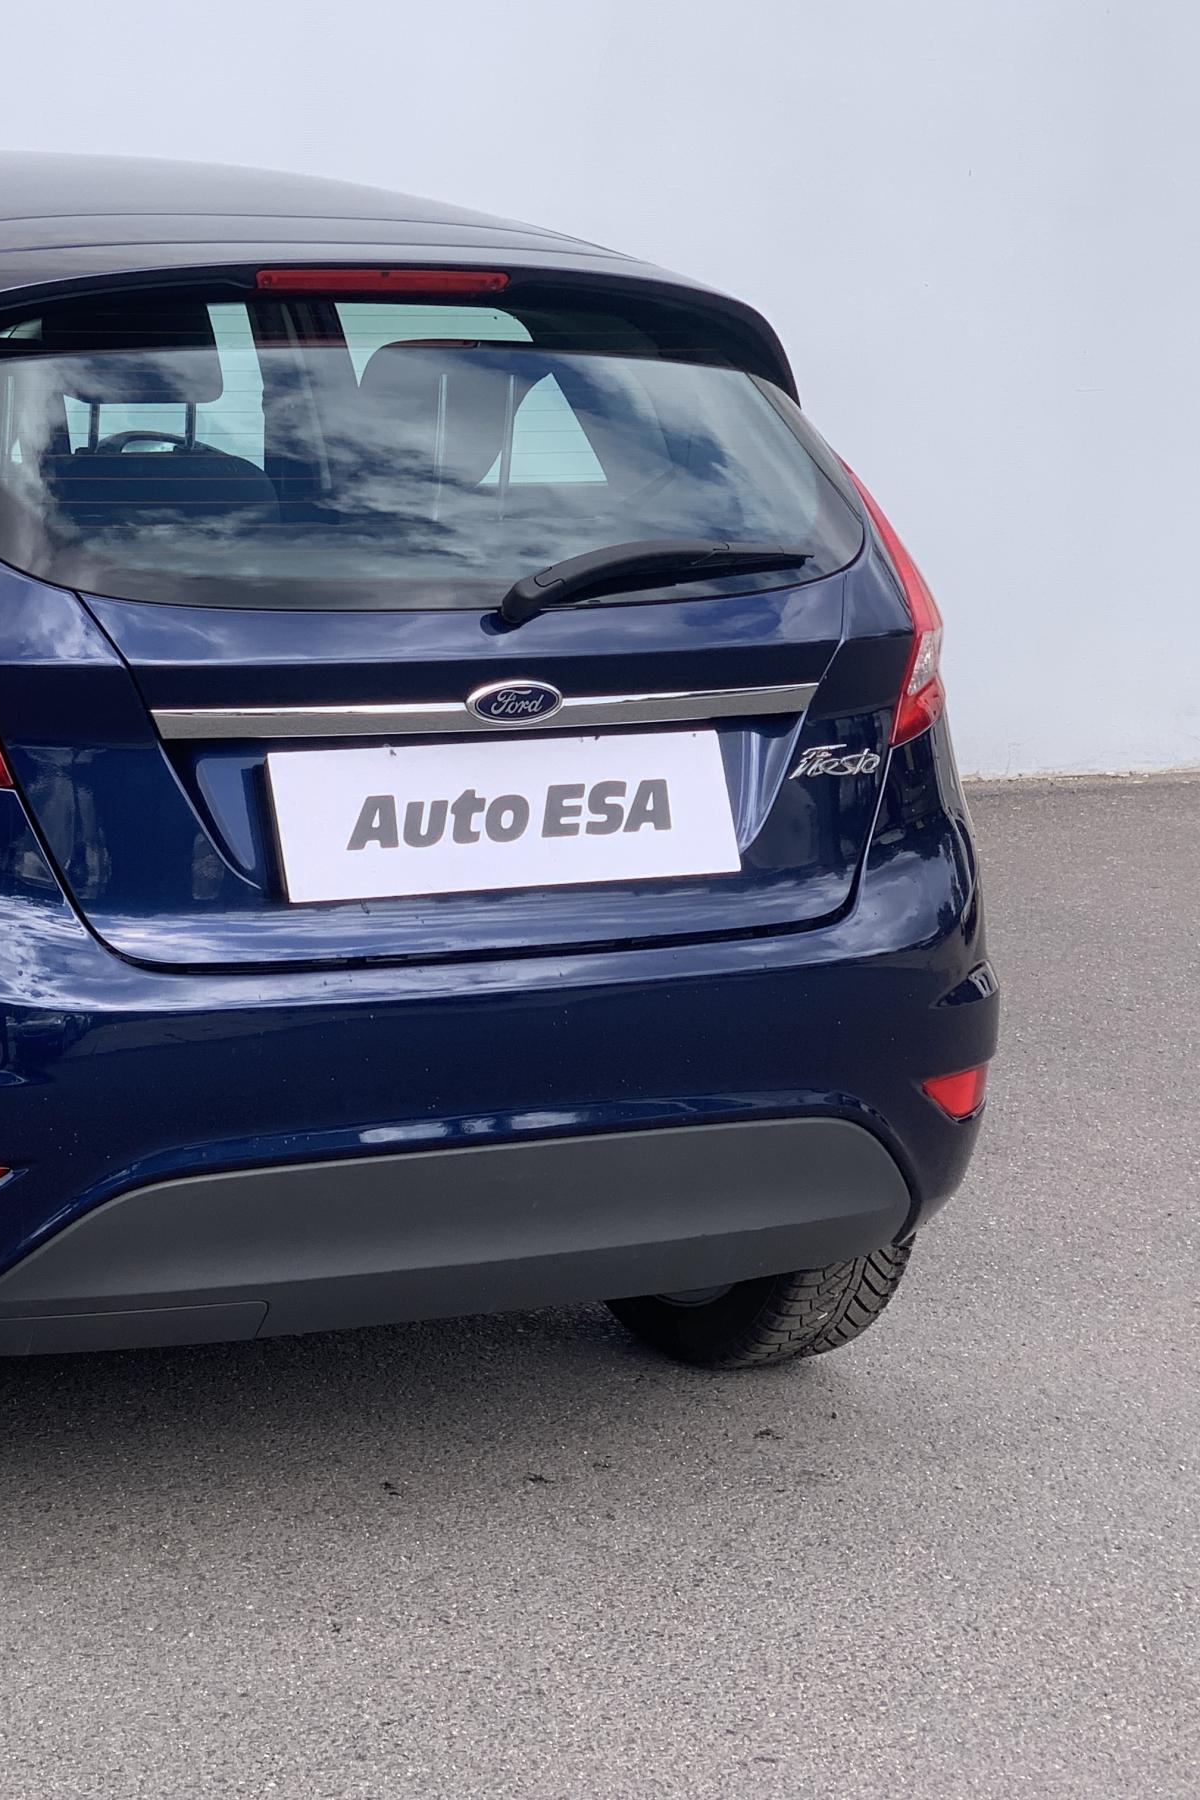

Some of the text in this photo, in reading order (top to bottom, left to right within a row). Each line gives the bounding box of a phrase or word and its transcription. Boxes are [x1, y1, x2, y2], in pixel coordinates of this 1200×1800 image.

[490, 689, 544, 715] Ford
[788, 743, 881, 780] Fiesta
[347, 779, 672, 850] Auto ESA
